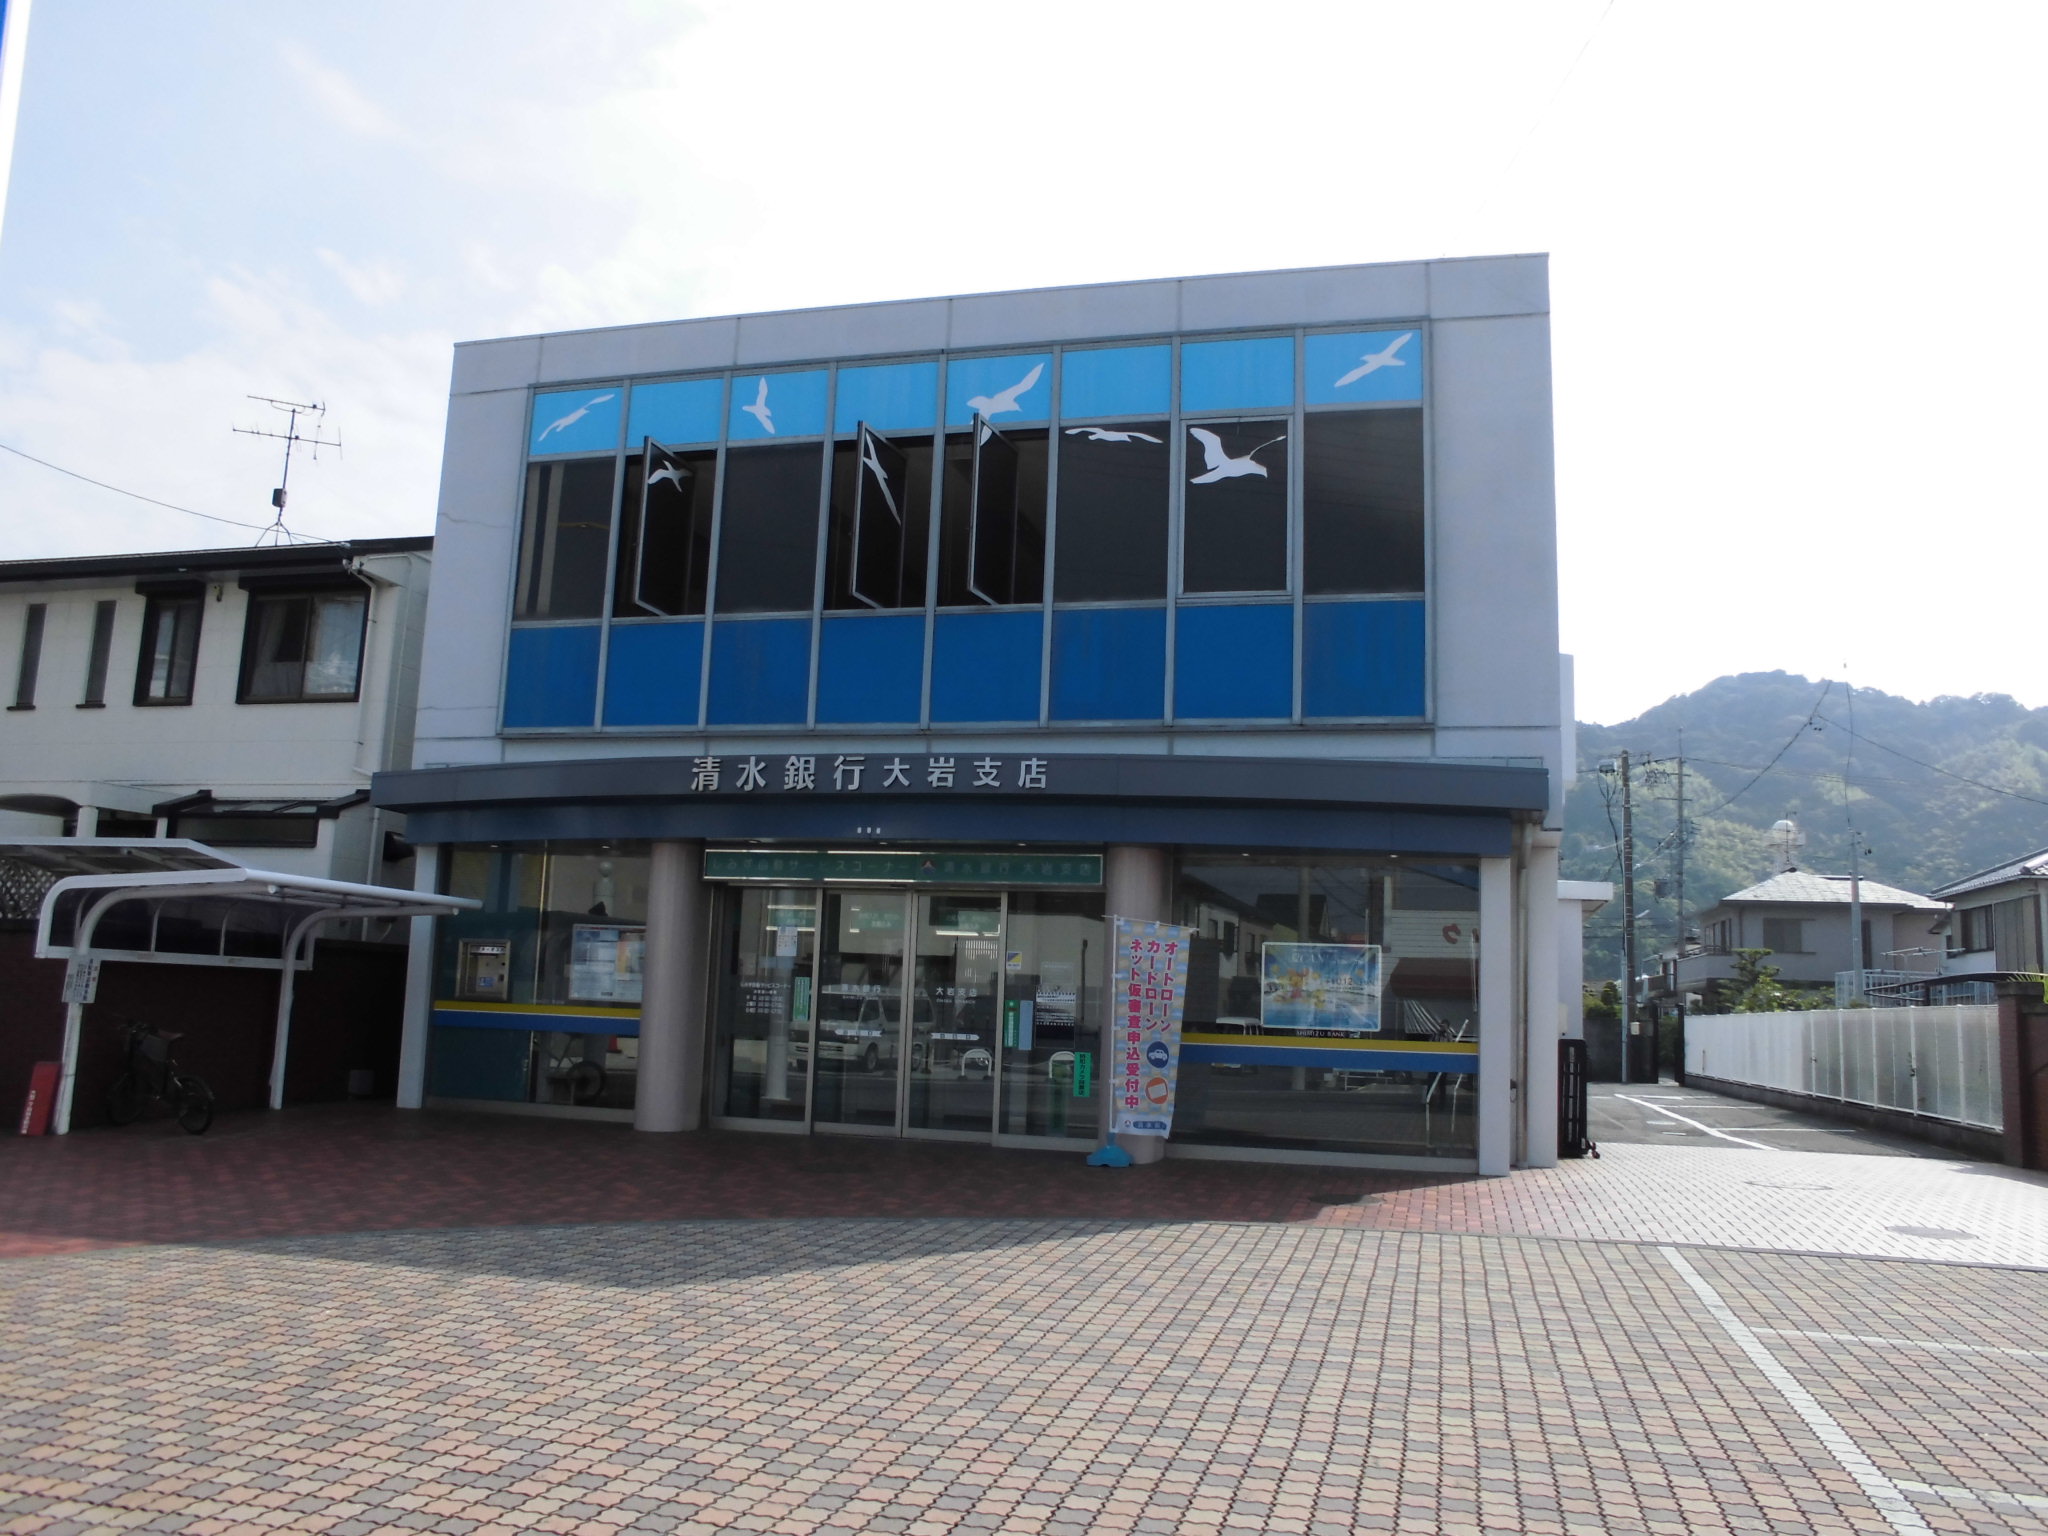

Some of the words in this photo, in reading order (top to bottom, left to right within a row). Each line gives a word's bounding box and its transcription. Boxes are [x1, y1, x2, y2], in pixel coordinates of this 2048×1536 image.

[690, 755, 1049, 791] 清水銀行大岩支店
[1124, 939, 1143, 1109] ネット仮審査申込受付中
[1145, 940, 1161, 1031] カードローン
[1160, 942, 1178, 1032] オートローン
